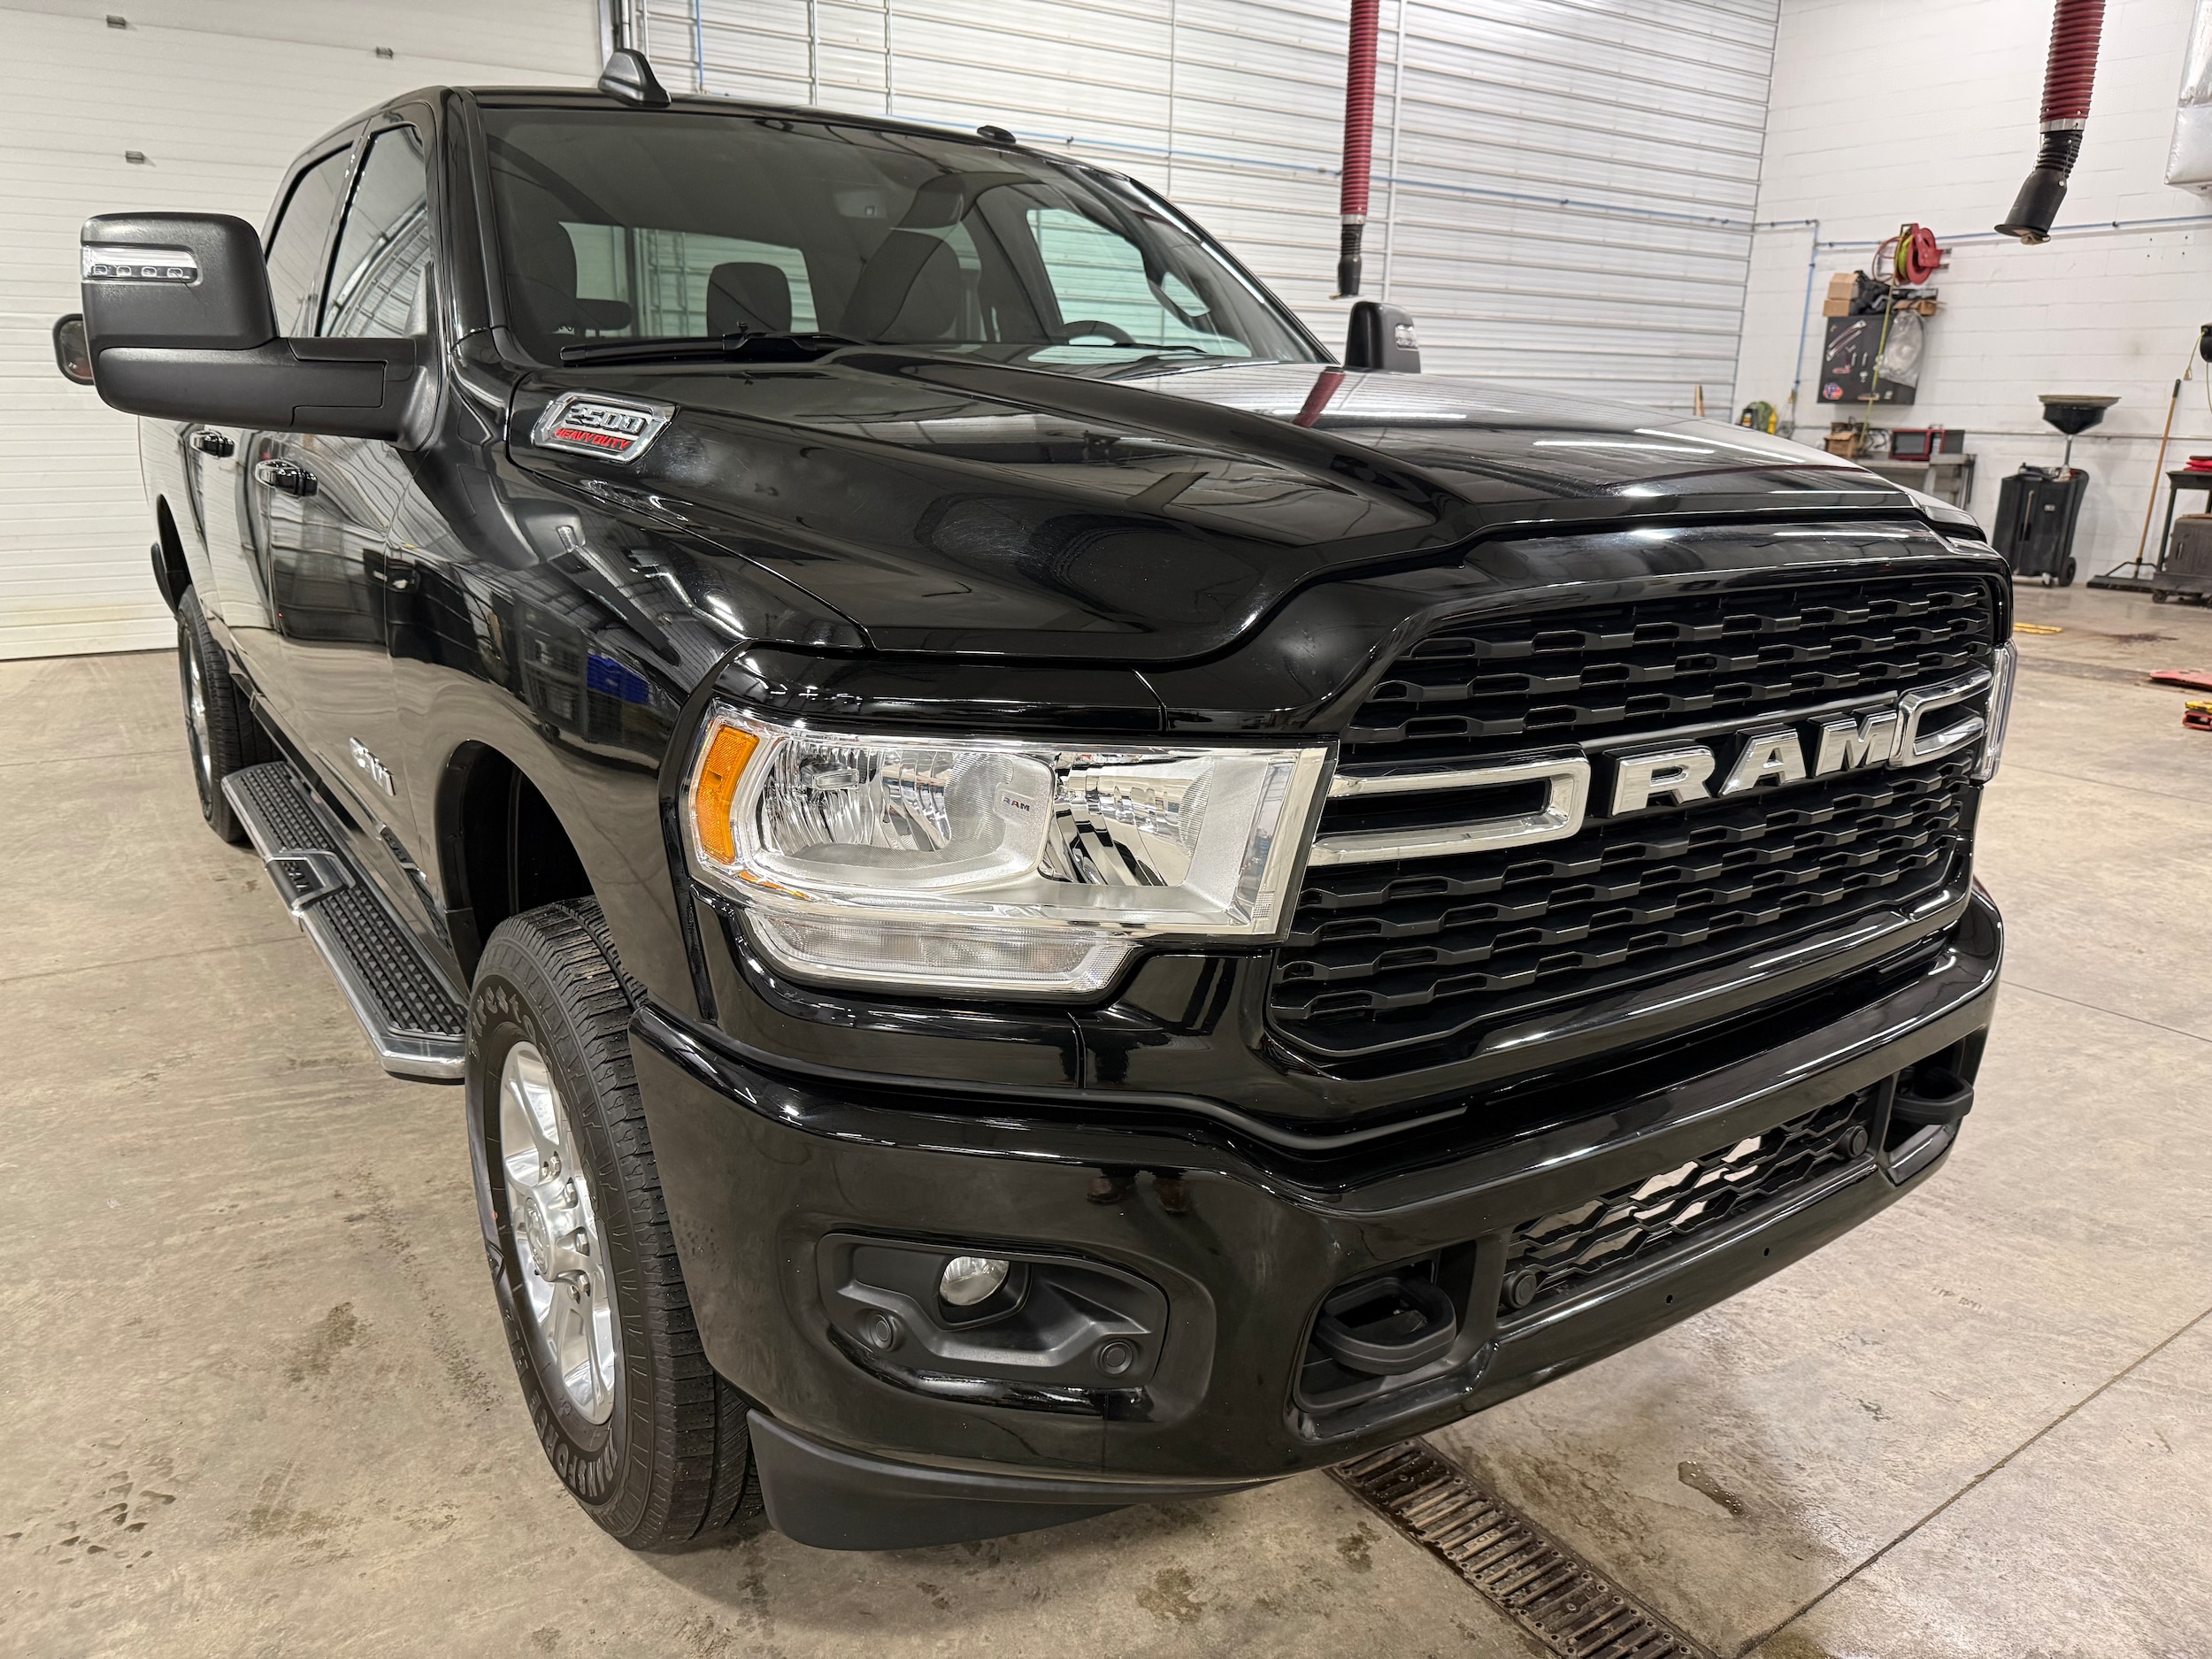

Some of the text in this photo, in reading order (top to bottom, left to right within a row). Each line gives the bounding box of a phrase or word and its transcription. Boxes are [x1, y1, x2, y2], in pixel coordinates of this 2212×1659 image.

[565, 405, 645, 434] 2500
[555, 428, 632, 450] HEAVY DUTY
[1606, 710, 1897, 818] RAM
[1002, 796, 1030, 811] RAM
[1465, 1528, 1499, 1549] NDS
